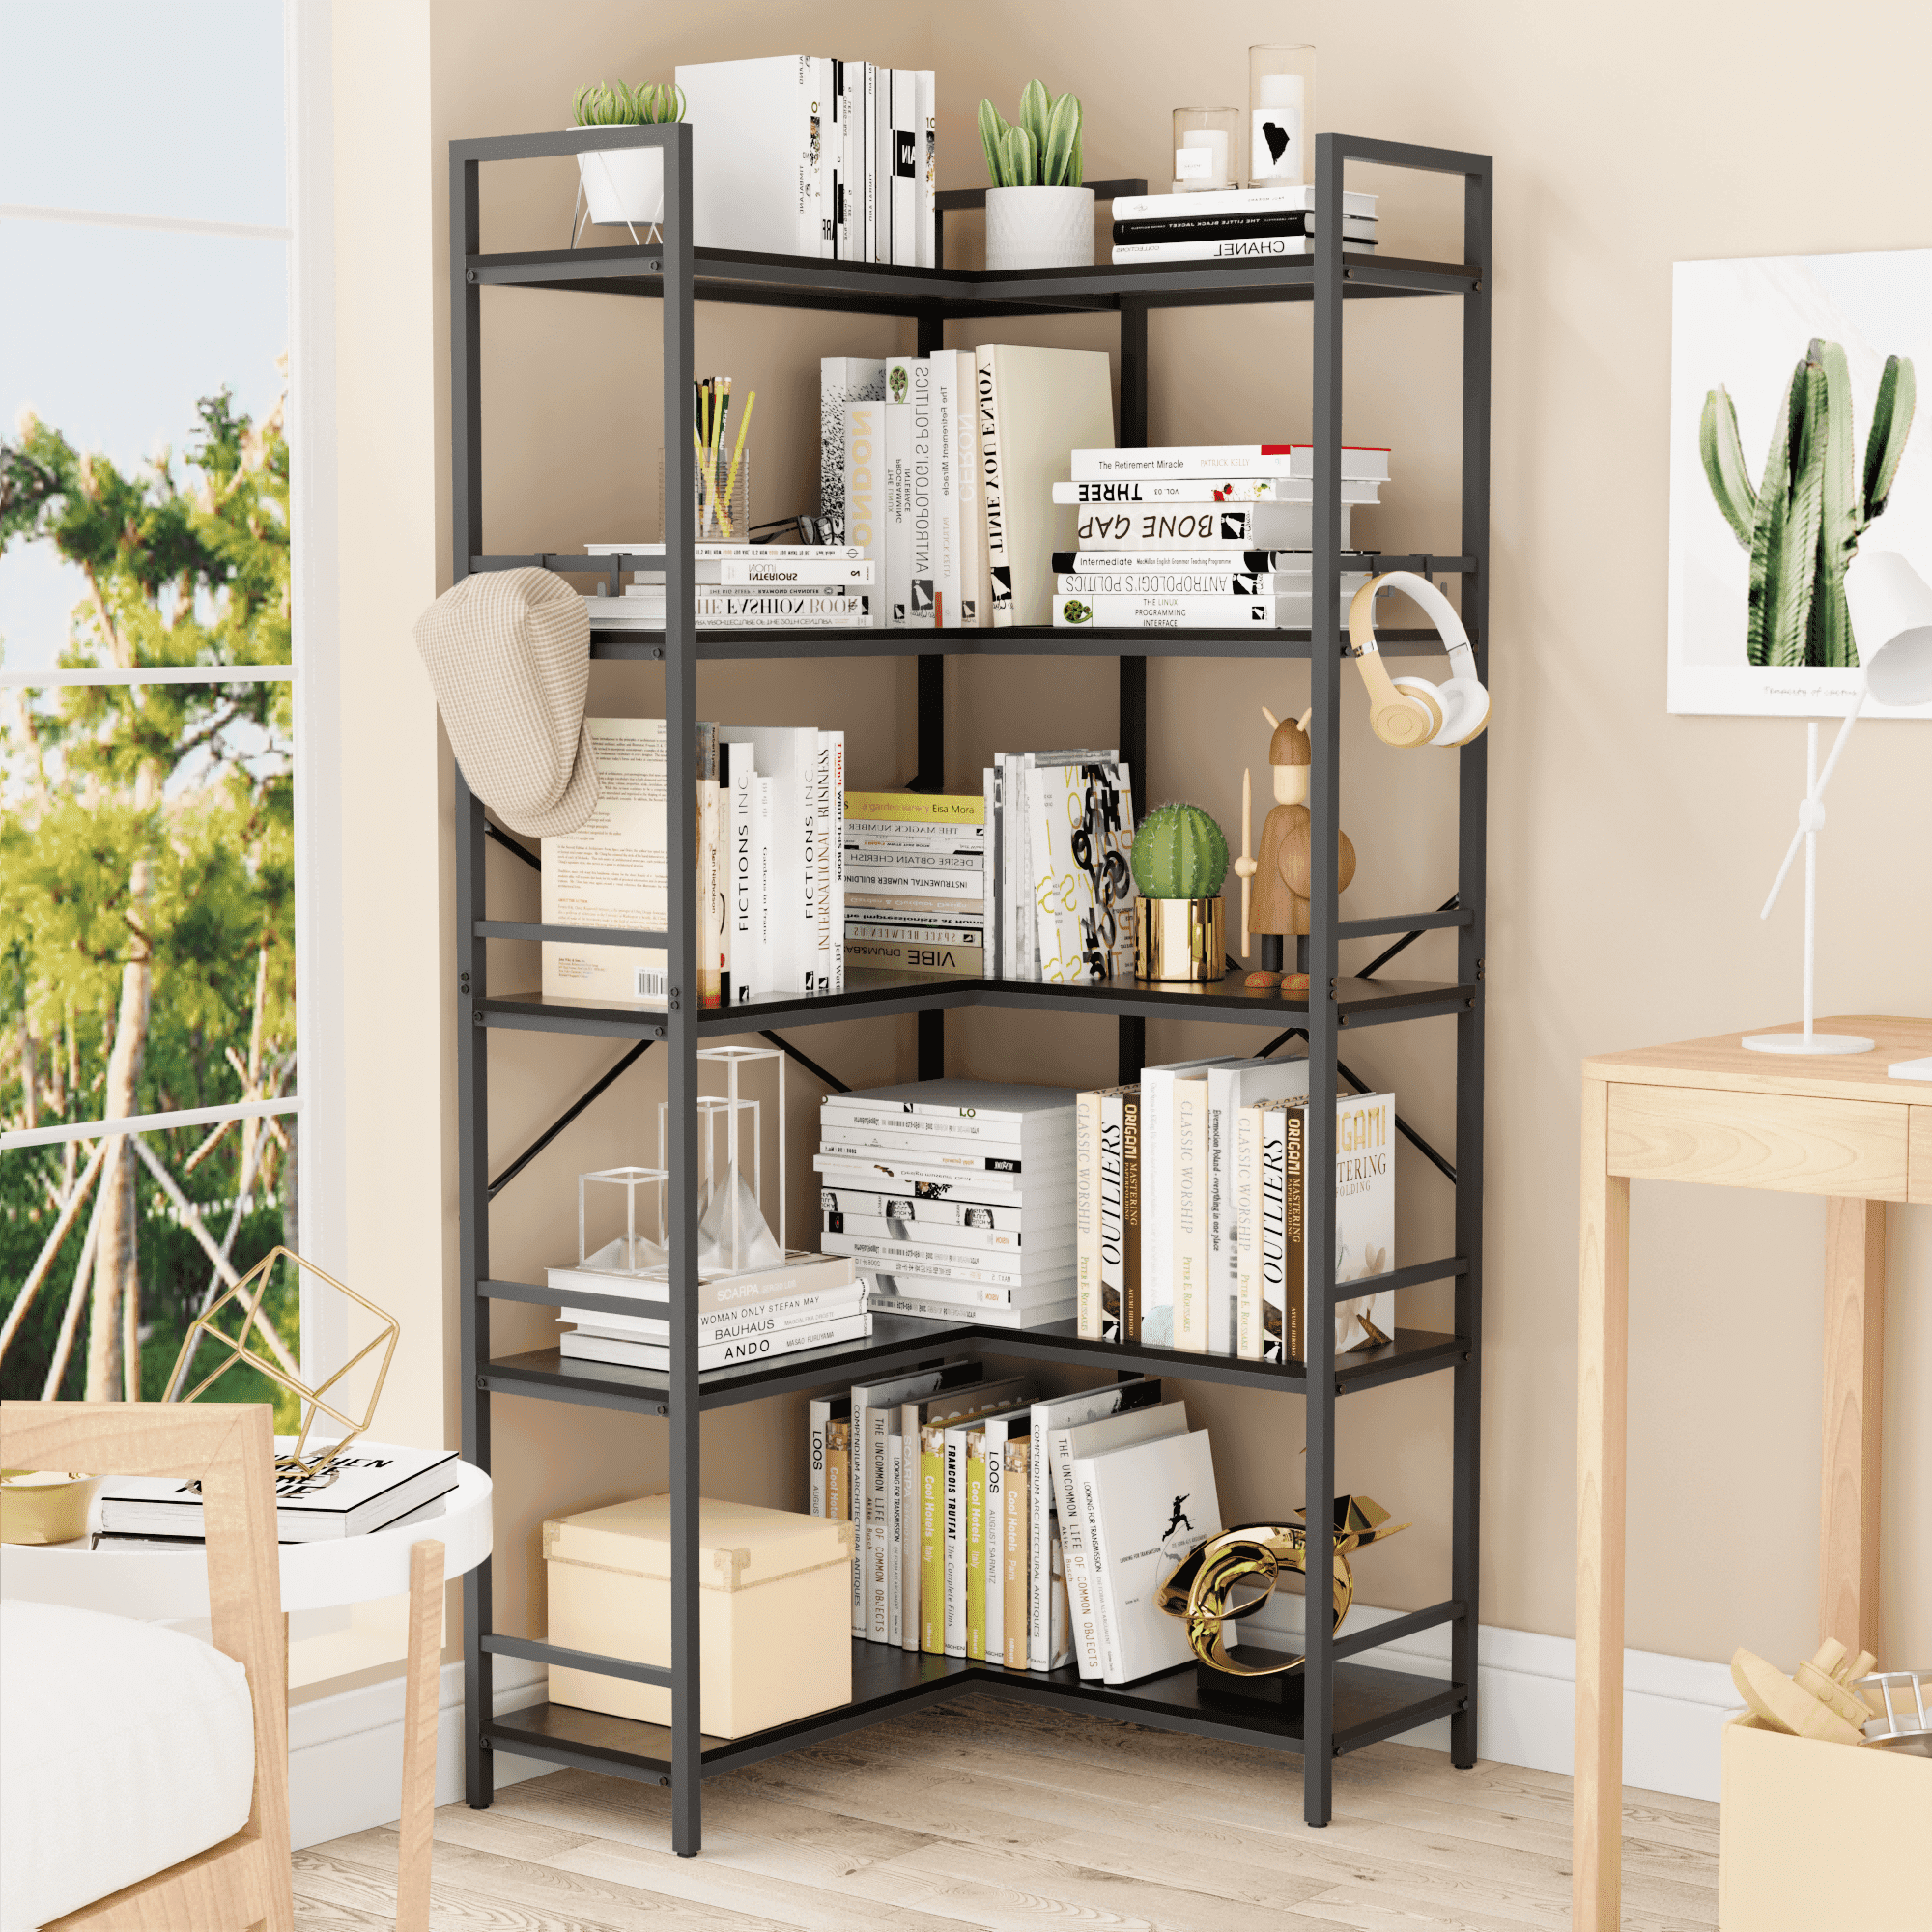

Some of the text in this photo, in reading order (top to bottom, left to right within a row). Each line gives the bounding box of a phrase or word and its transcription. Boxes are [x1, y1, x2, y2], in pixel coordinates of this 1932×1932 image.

[1099, 458, 1250, 469] The Retirement Miracle PATRICK KELLY
[1079, 484, 1142, 501] THREE
[1079, 515, 1213, 539] BONE GAP
[1080, 557, 1133, 566] Intermediate
[1066, 575, 1227, 592] ANTROPOLOGI'S POLITICS
[870, 802, 974, 814] garden Eisa Mora
[739, 769, 748, 931] FICTIONS INC.
[805, 763, 814, 919] FICTIONS INC.
[818, 749, 829, 951] INTERNATIONAL BUSINESS
[878, 877, 967, 888] INSTRUMENTAL NUMBER
[908, 950, 956, 967] VIBE
[1078, 1103, 1089, 1162] CLASSIC
[1181, 1101, 1193, 1161] CLASSIC
[1288, 1118, 1300, 1175] ORIGAMI
[1125, 1104, 1137, 1225] ORIGAMI MASTERING
[1211, 1109, 1221, 1251] Evermotion Poland everything place
[1078, 1166, 1090, 1234] WORSHIP
[1102, 1122, 1121, 1265] OUTLIERS
[1180, 1166, 1193, 1234] WORSHIP
[1238, 1118, 1250, 1299] CLASSIC WORSHIP PETER
[1264, 1137, 1282, 1283] OUTLIERS
[701, 1296, 820, 1326] WOMAN ONLY STEFAN MAY
[717, 1283, 759, 1302] SCARPA
[715, 1319, 774, 1340] BAUHAUS
[724, 1331, 834, 1360] ANDO MASAO FURUYAMA
[305, 1455, 394, 1469] THEN
[813, 1430, 823, 1470] LOOS
[829, 1467, 838, 1491] Cool
[925, 1476, 934, 1499] Cool
[972, 1481, 981, 1504] Cool
[989, 1451, 999, 1494] LOOS
[875, 1418, 884, 1632] THE UNCOMMON LIFE OF COMMON OBJECTS
[925, 1502, 934, 1537] Hotels
[972, 1508, 981, 1543] Hotels
[1008, 1490, 1018, 1581] Cool Hotels Paris
[1084, 1481, 1102, 1573] LOOKING TRANSMISSION
[1059, 1438, 1098, 1668] THE UNCOMMON LIFE OF COMMON OBJECTS
